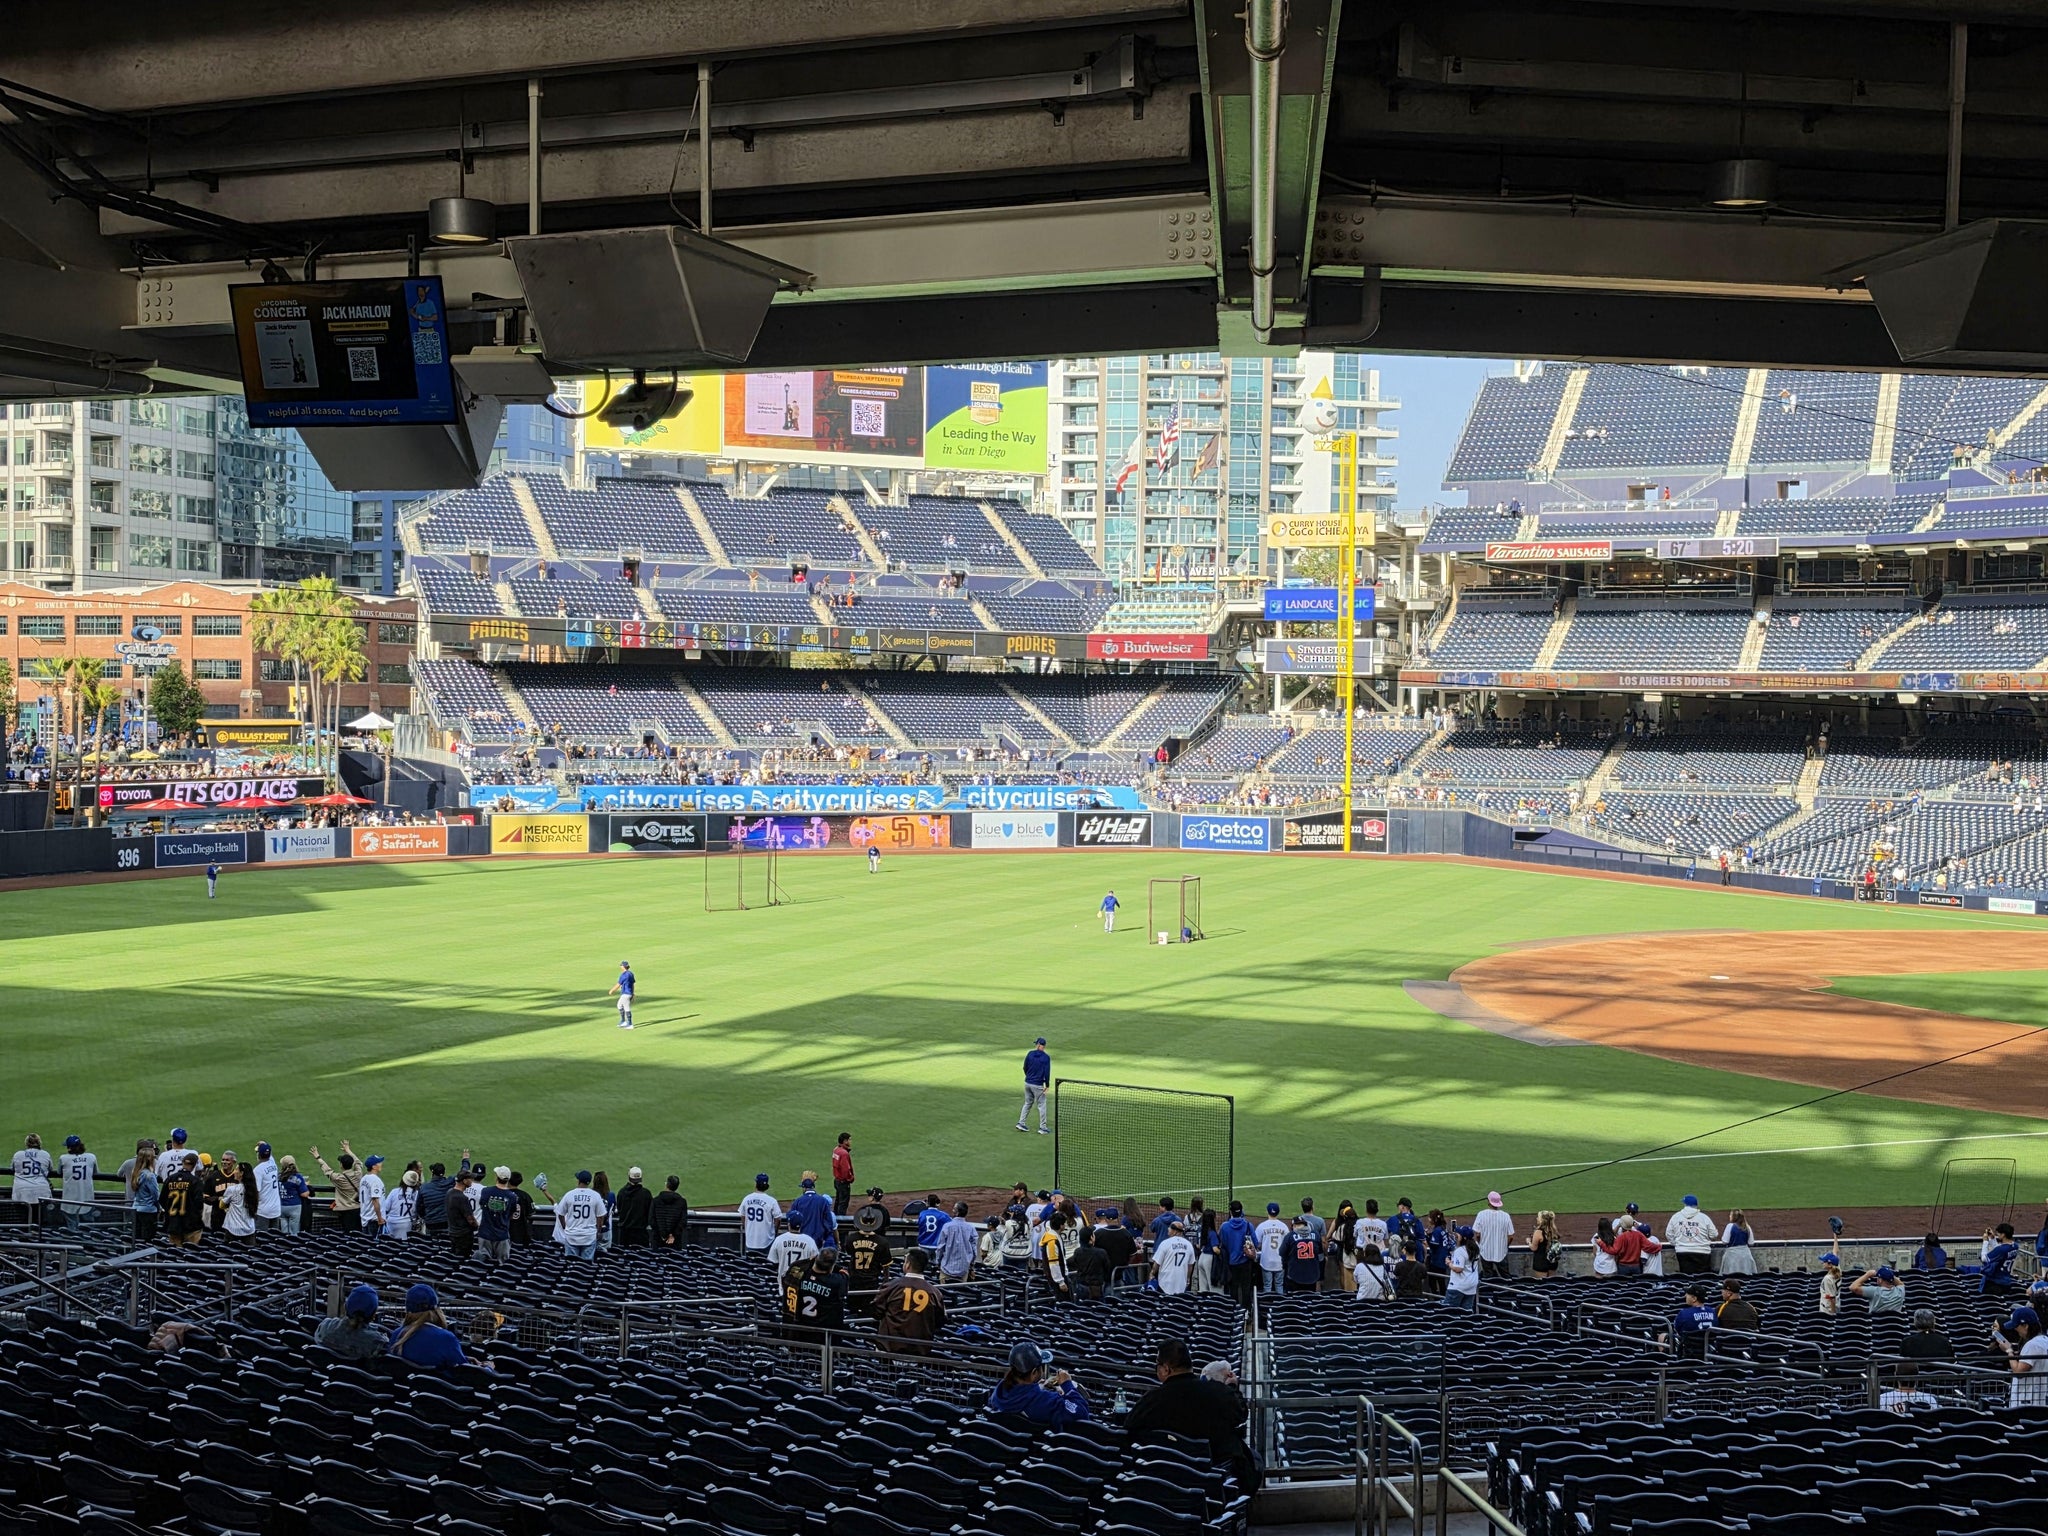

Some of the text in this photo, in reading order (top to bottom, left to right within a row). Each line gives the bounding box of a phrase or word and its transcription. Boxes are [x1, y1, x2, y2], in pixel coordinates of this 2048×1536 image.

[253, 306, 307, 318] CONCERT
[322, 305, 391, 320] JACK HARLOW
[1003, 362, 1032, 375] Health
[837, 374, 865, 382] THURSDAY,
[973, 384, 997, 394] BEST
[268, 406, 401, 418] Helpful all season. And beyond.
[943, 427, 1036, 445] Leading the Way
[942, 444, 1006, 459] in San Diego
[1289, 528, 1313, 536] CoCo
[1489, 544, 1609, 559] Tarantino SAUSAGES
[1722, 540, 1754, 556] 5:20
[35, 601, 68, 609] SHOWLEY
[1285, 600, 1335, 610] LANDCARE
[375, 610, 393, 618] CANDY
[469, 620, 529, 642] PADRES
[585, 621, 591, 632] 0
[640, 623, 646, 633] 2
[692, 624, 700, 635] 4
[745, 625, 750, 637] 1
[585, 635, 592, 646] 6
[640, 636, 646, 647] 3
[763, 632, 769, 644] 3
[801, 635, 818, 644] 5:40
[851, 636, 868, 646] 6:40
[894, 637, 925, 646] @PADRES
[940, 638, 974, 647] @PADRES
[117, 642, 178, 657] Gallagher
[1007, 635, 1056, 655] PADRES
[1124, 641, 1194, 654] Budweiser
[1298, 645, 1349, 654] SINGLETO
[125, 654, 171, 668] Square
[1619, 677, 1731, 687] LOS ANGELES DODGERS
[1761, 677, 1854, 687] SAN DIEGO PADRES
[229, 732, 263, 740] BALLAST
[115, 790, 152, 801] TOYOTA
[165, 779, 297, 803] LET'S GO PLACES
[606, 788, 745, 811] citycruises
[773, 788, 910, 811] citycruises
[524, 824, 583, 835] MERCURY
[975, 823, 1043, 835] blue blue
[1209, 822, 1264, 841] petco
[1302, 824, 1345, 835] SLAP SOME
[290, 835, 330, 847] National
[383, 838, 439, 849] Safari Park
[524, 834, 583, 843] INSURANCE
[1098, 833, 1140, 843] POWER
[1302, 836, 1327, 845] CHEESE
[1327, 836, 1338, 844] ON
[164, 842, 239, 856] UC San Diego Health
[118, 848, 140, 868] 396
[72, 1166, 88, 1181] 51
[167, 1191, 187, 1217] 21
[573, 1204, 591, 1219] 50
[747, 1207, 764, 1222] 99
[925, 1215, 938, 1233] B
[784, 1240, 807, 1250] OHTANI
[852, 1240, 878, 1251] CHAVEZ
[1270, 1236, 1279, 1249] 5
[1297, 1241, 1315, 1259] 21
[855, 1251, 874, 1270] 27
[1174, 1252, 1186, 1267] 17
[801, 1281, 831, 1297] GAERTS
[903, 1287, 930, 1313] 19
[802, 1296, 818, 1317] 2
[1693, 1311, 1714, 1321] OHTANI
